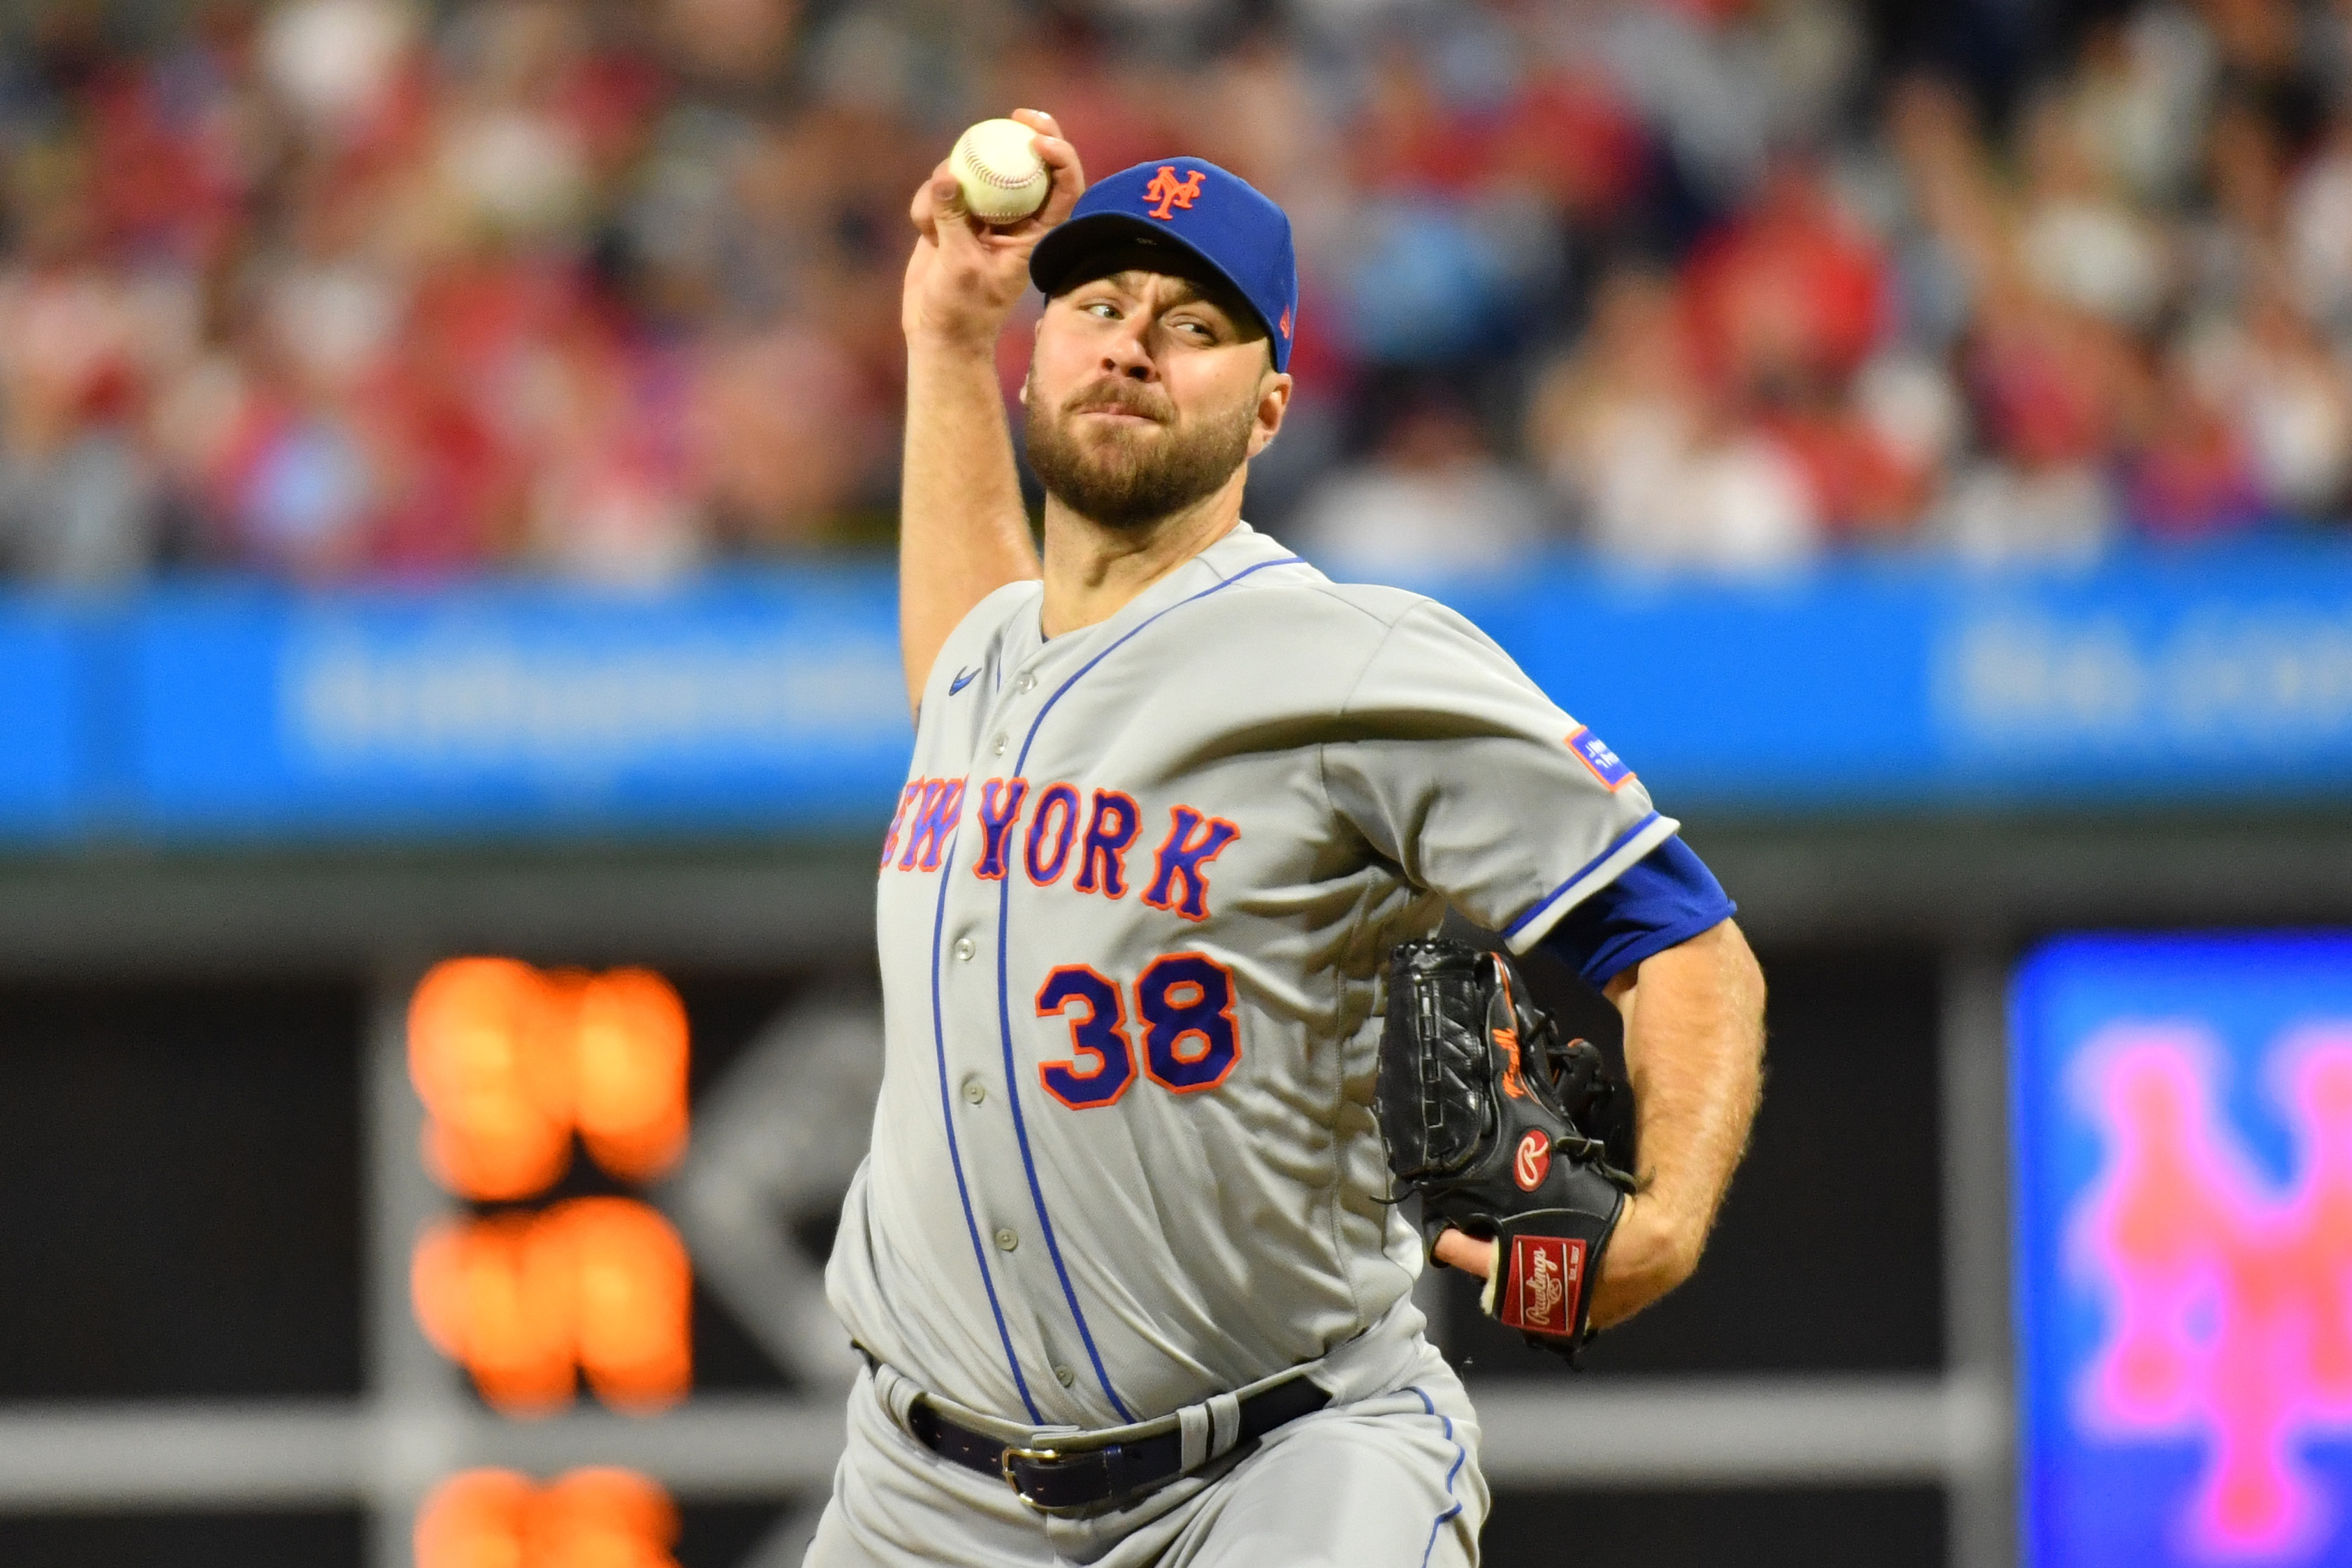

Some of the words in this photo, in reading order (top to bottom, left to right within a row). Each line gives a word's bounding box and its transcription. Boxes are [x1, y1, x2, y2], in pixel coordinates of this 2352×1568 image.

[972, 776, 1242, 923] YORK
[1034, 951, 1242, 1111] 38
[1525, 1247, 1558, 1326] Rawlings
